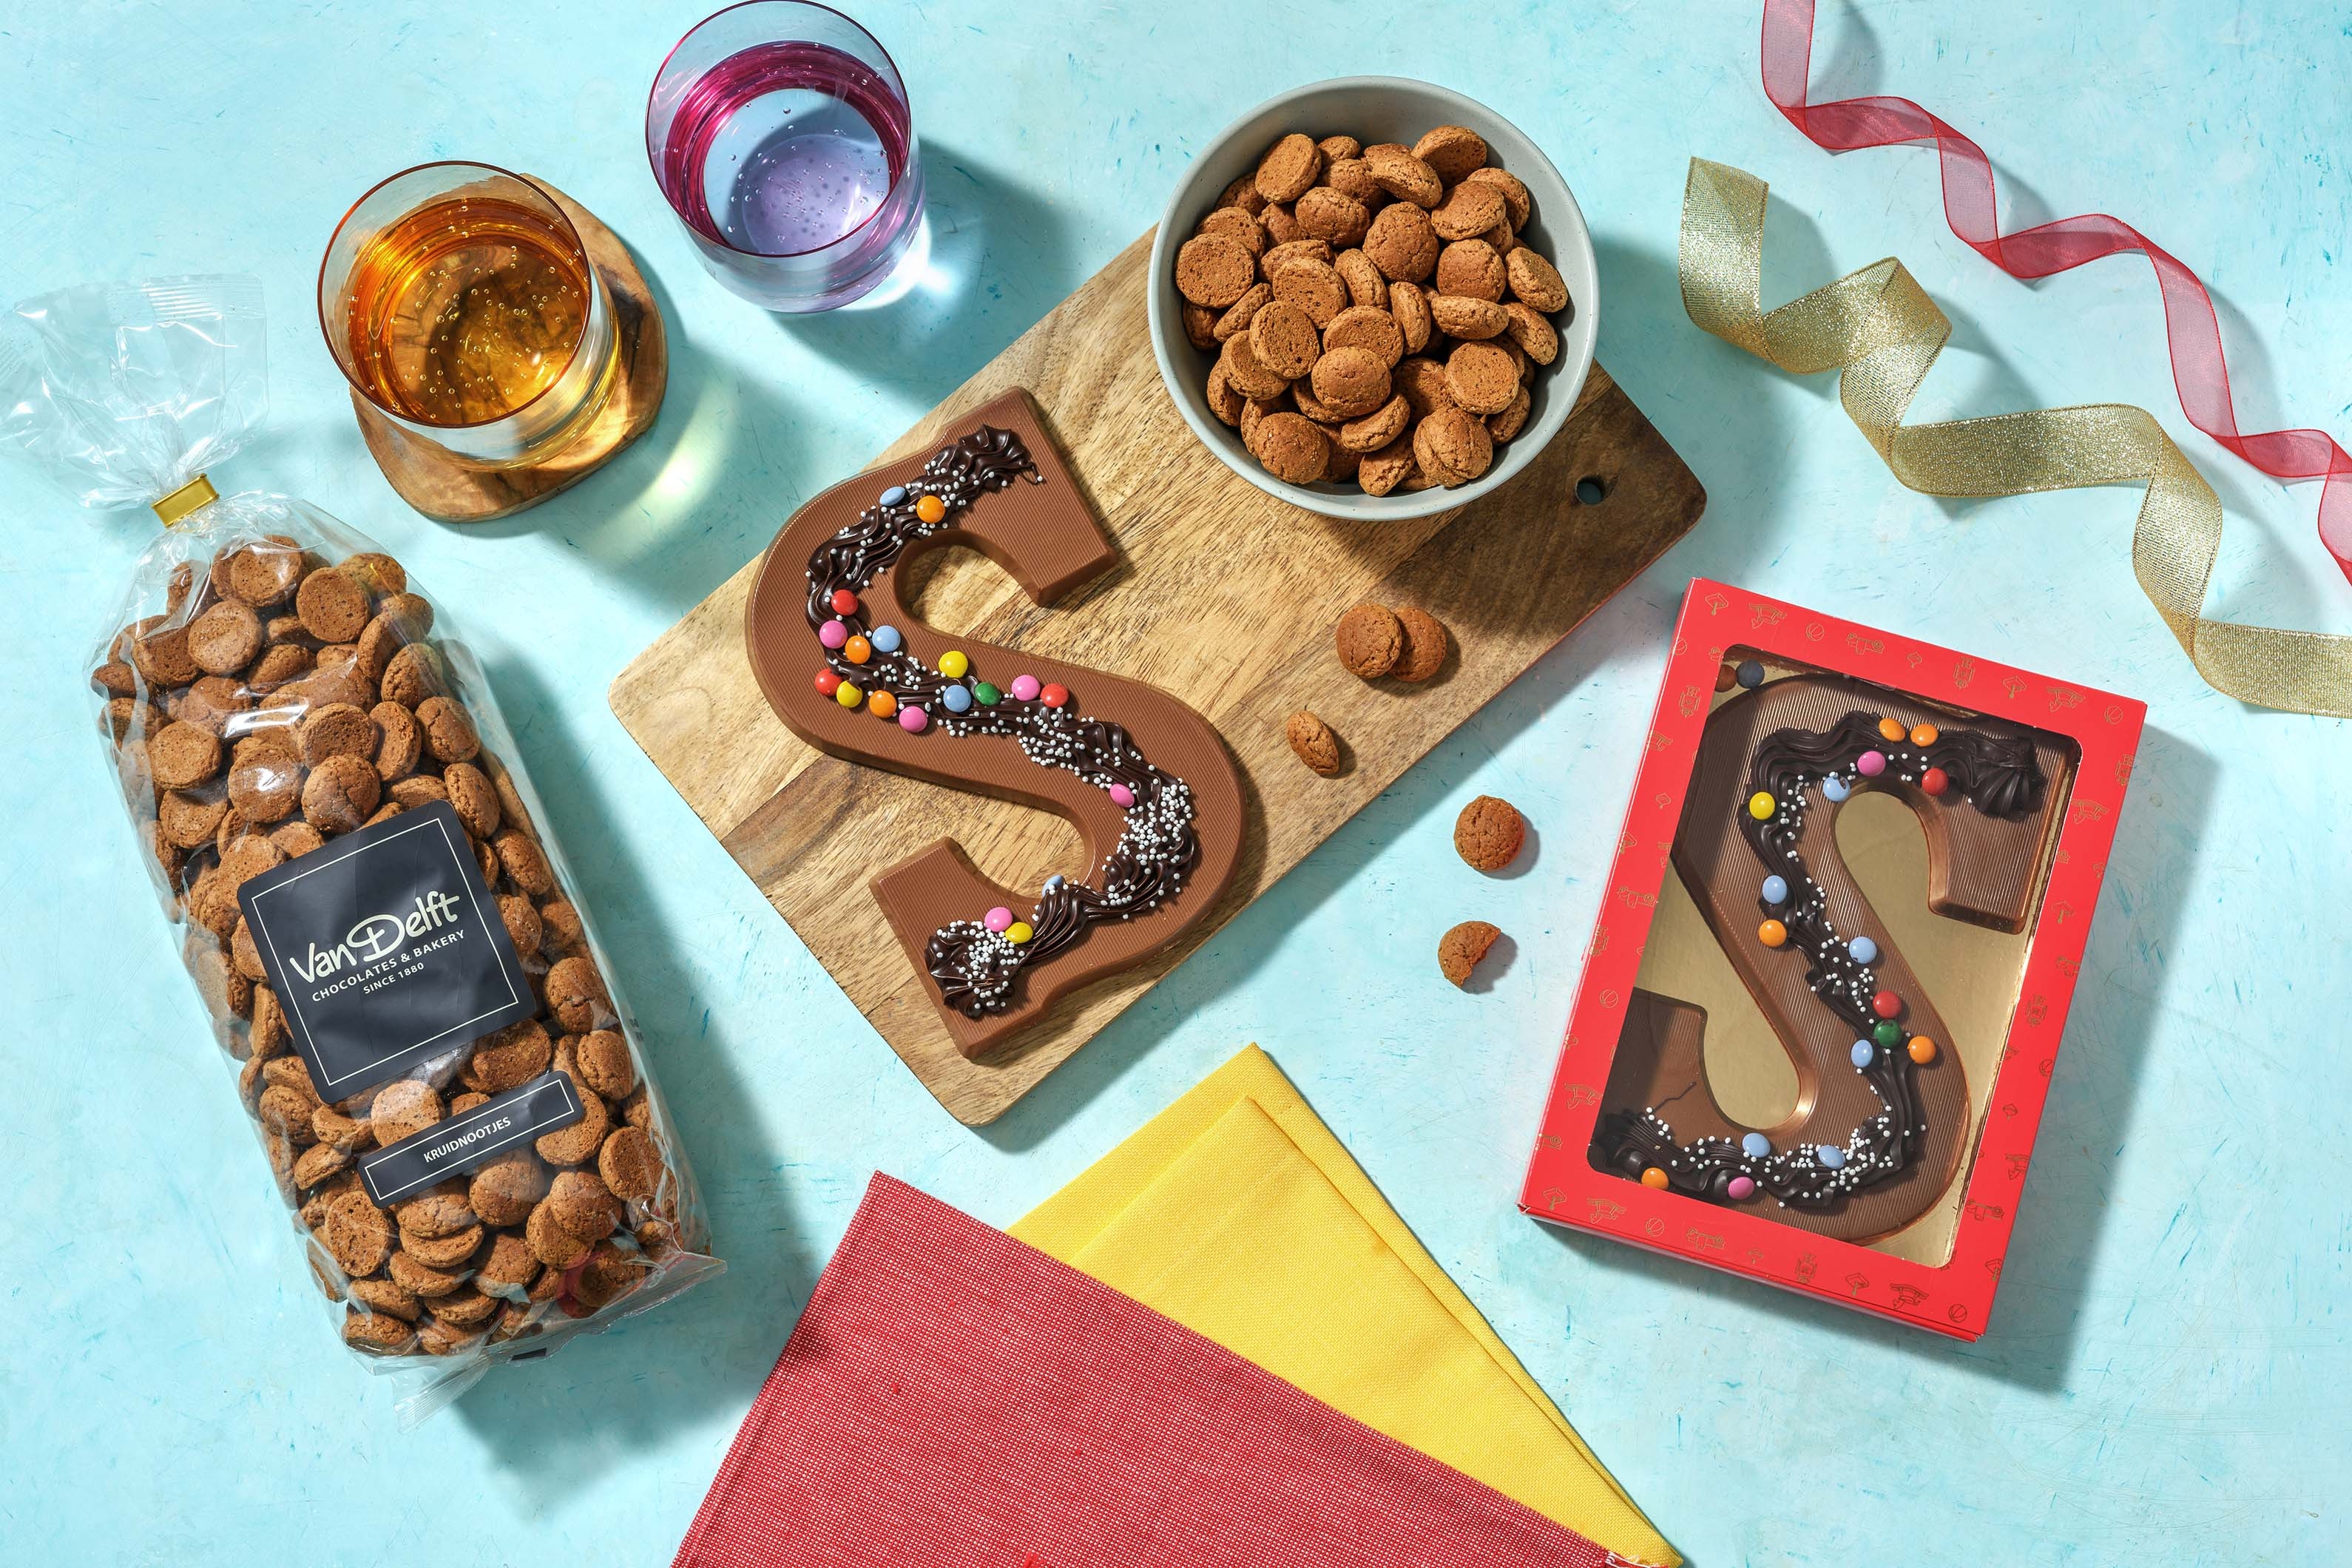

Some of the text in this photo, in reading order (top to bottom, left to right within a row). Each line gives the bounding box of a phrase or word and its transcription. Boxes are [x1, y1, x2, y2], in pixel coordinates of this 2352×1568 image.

[312, 929, 465, 1002] CHOCOLATES & BAKERY
[363, 962, 425, 994] SINCE 1880
[423, 1116, 512, 1163] KRUIDNOOTJES
